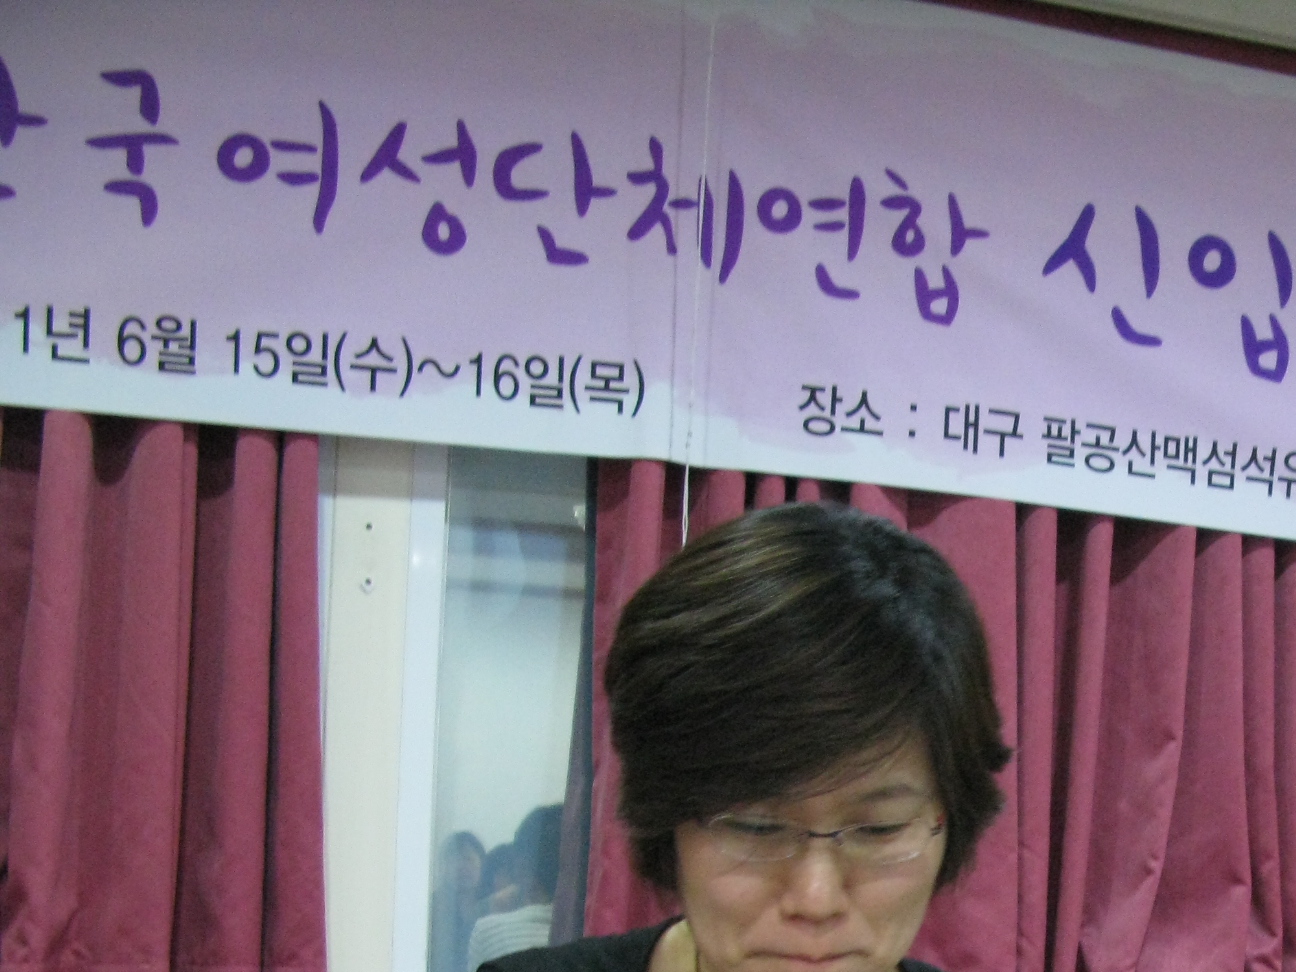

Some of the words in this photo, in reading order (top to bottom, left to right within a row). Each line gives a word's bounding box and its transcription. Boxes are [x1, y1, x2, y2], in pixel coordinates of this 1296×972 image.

[116, 314, 198, 376] 6월
[797, 382, 884, 439] 장소
[943, 402, 1025, 460] 대구
